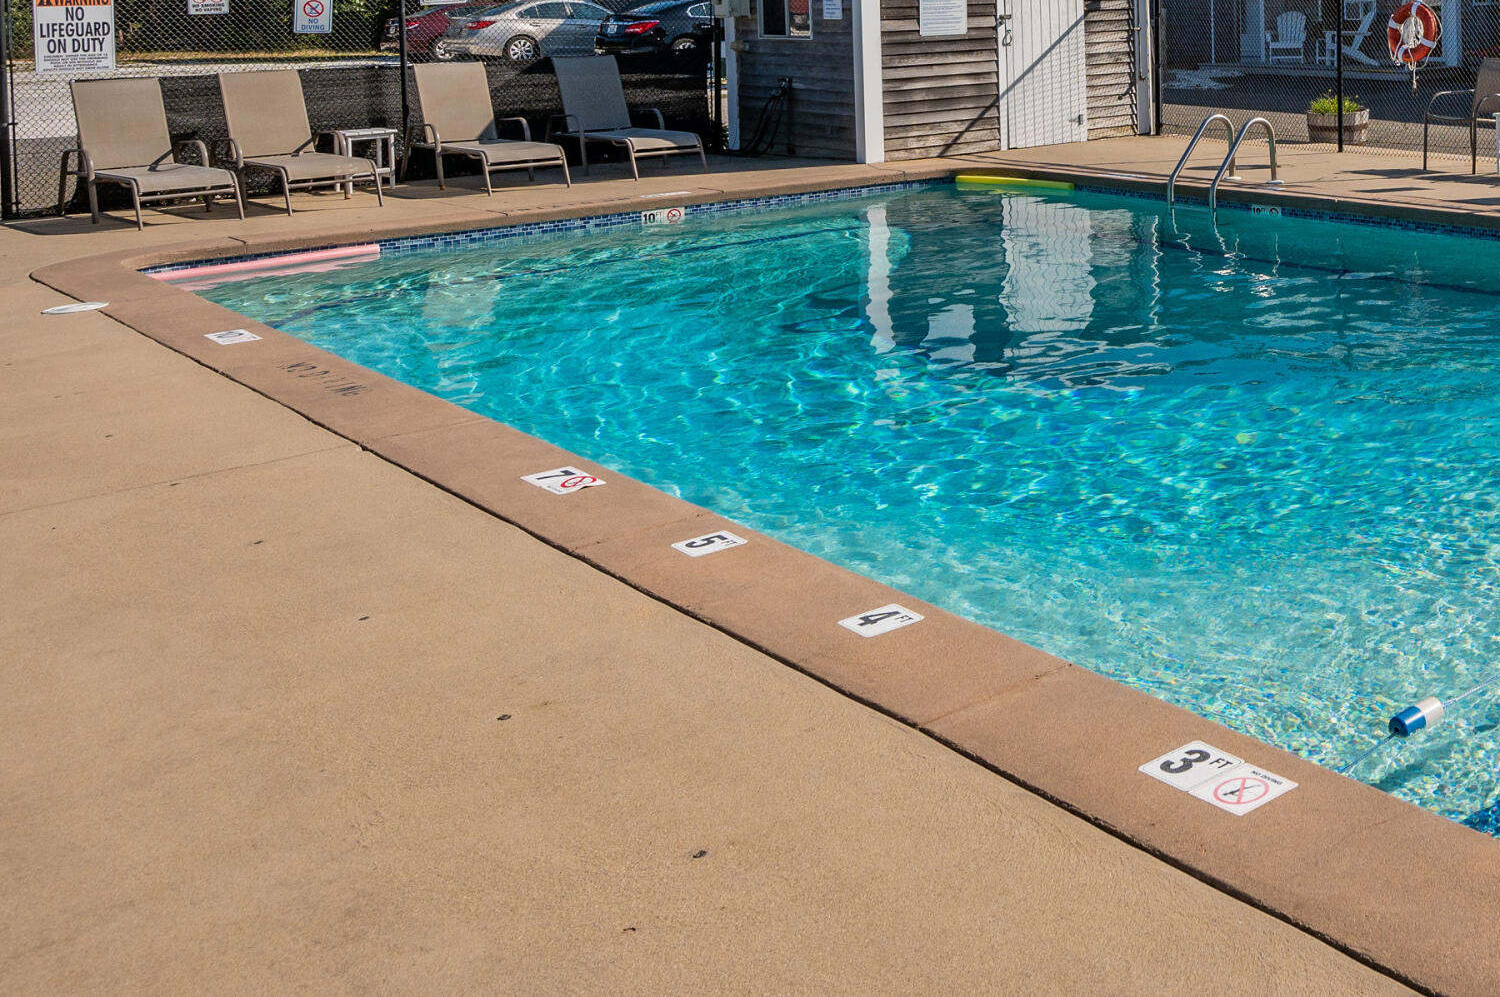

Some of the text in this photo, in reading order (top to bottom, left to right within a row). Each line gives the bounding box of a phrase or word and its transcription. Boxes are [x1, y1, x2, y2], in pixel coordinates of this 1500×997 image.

[66, 6, 85, 21] NO
[40, 22, 111, 38] LIFEGUARD
[47, 37, 105, 54] ON DUTY
[643, 213, 655, 224] 10
[536, 469, 577, 481] 7
[685, 534, 728, 548] 5
[857, 610, 901, 627] 4
[1159, 749, 1234, 774] 3 FT
